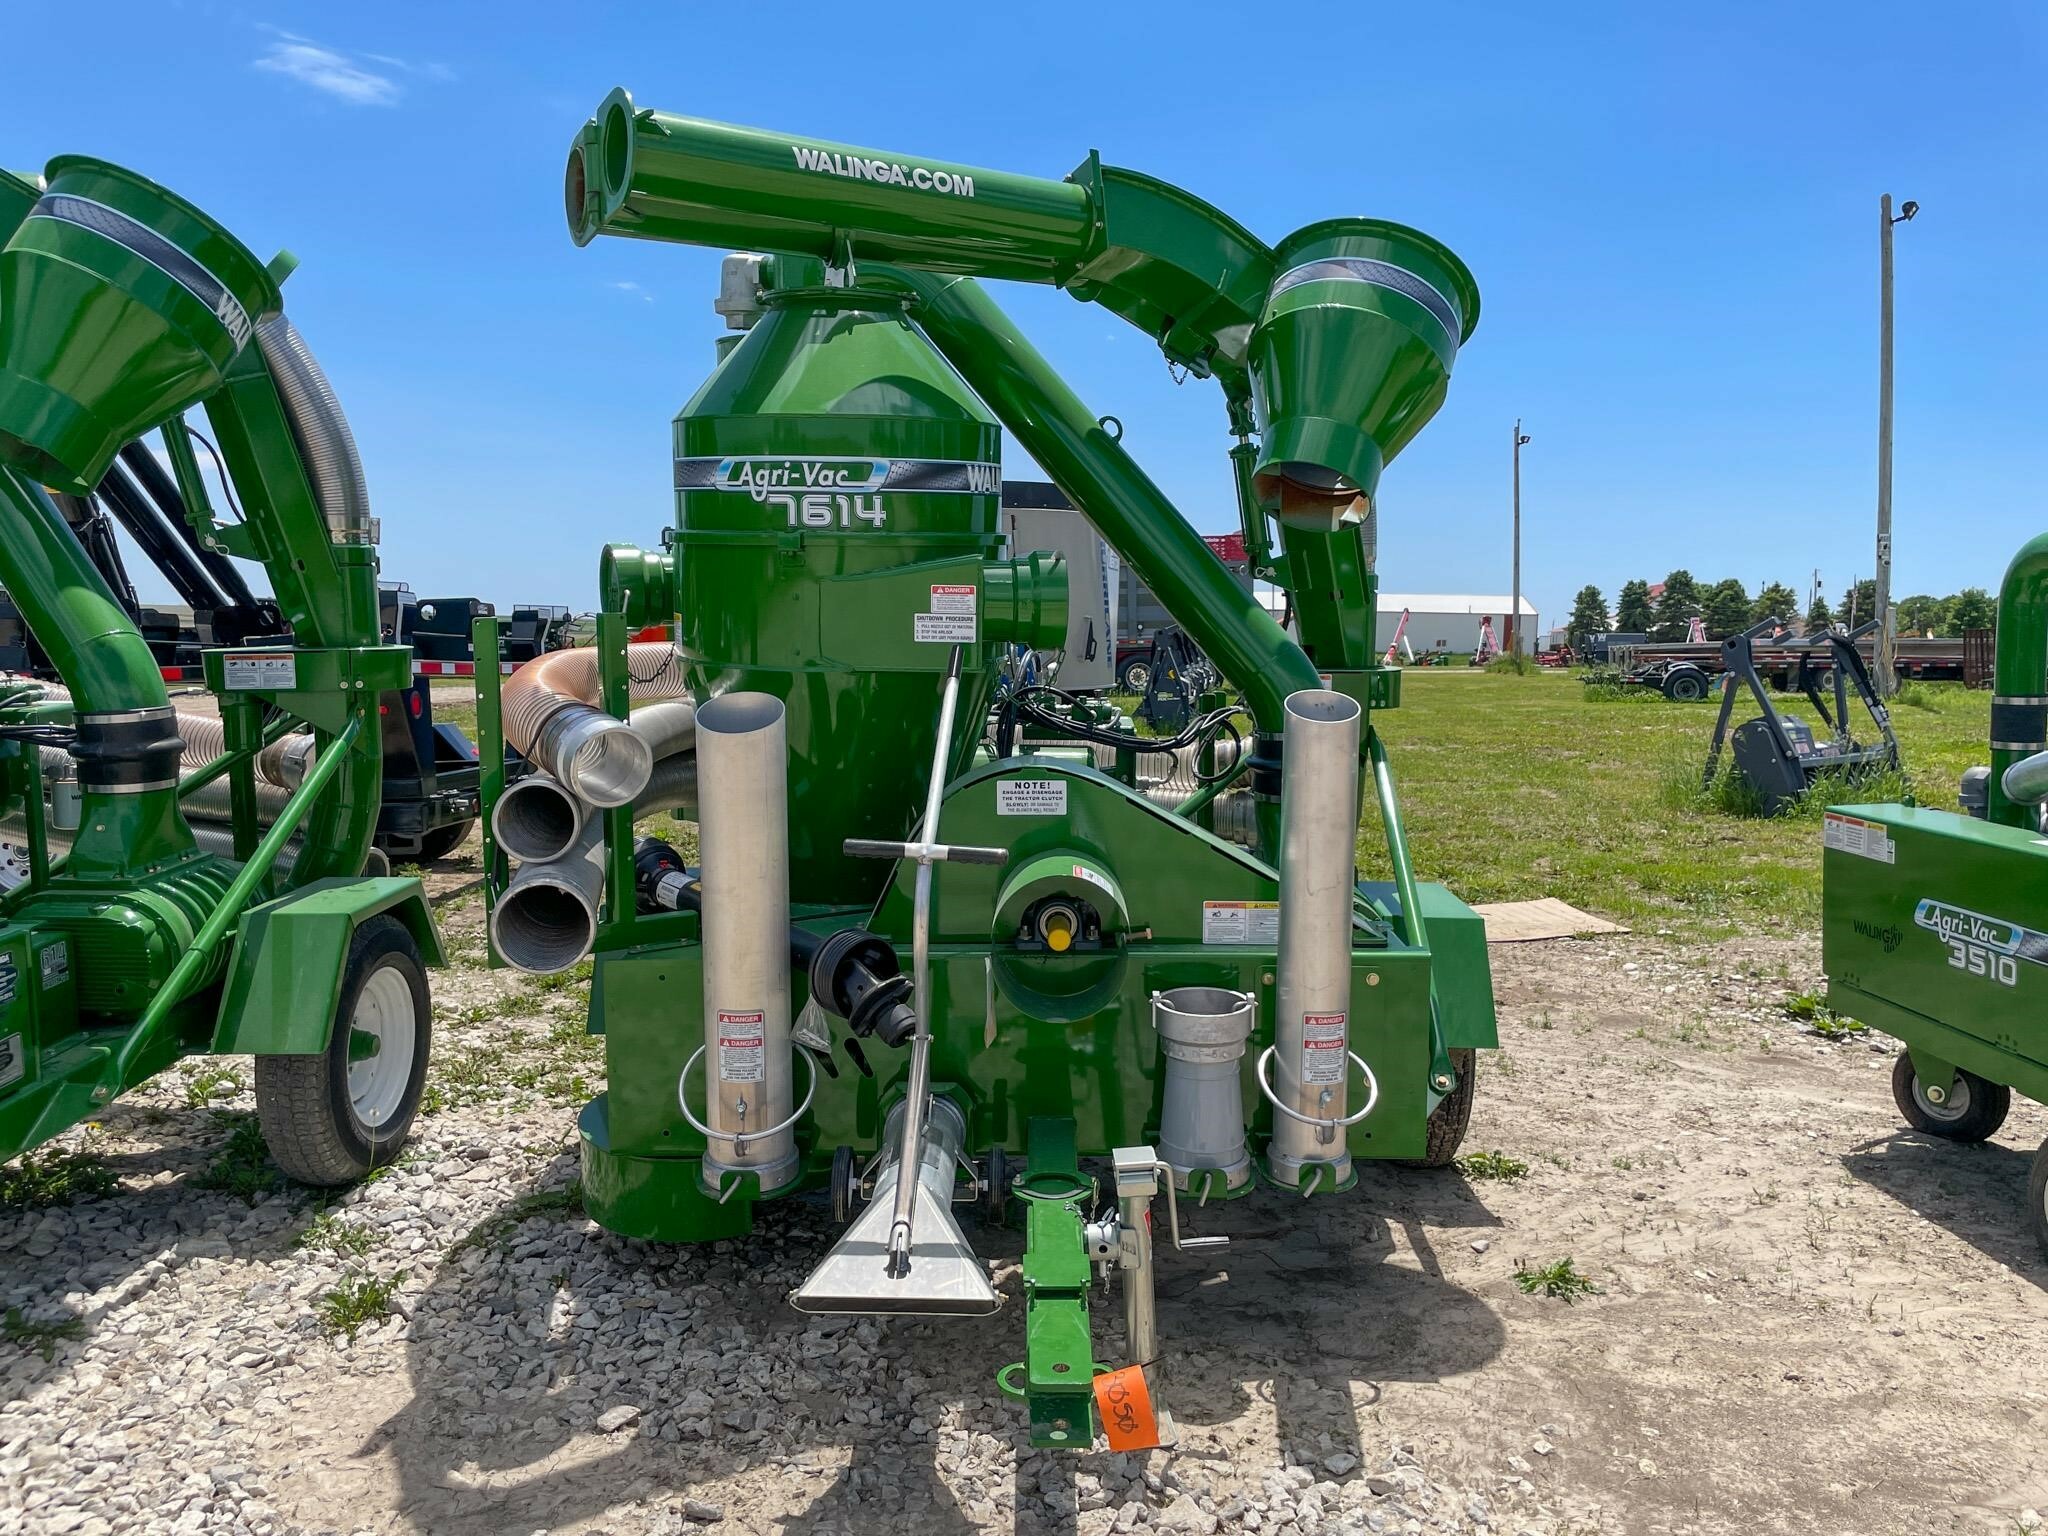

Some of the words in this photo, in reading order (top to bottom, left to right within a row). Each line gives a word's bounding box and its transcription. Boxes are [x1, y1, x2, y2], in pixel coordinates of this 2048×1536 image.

[738, 461, 850, 502] Agri-Vac
[766, 494, 887, 528] 7614
[1015, 781, 1050, 789] NOTE!
[1931, 906, 1998, 943] Agri-Vac
[1947, 938, 2017, 988] 3510
[730, 1015, 759, 1023] DANGER
[1318, 1016, 1343, 1024] DANGER
